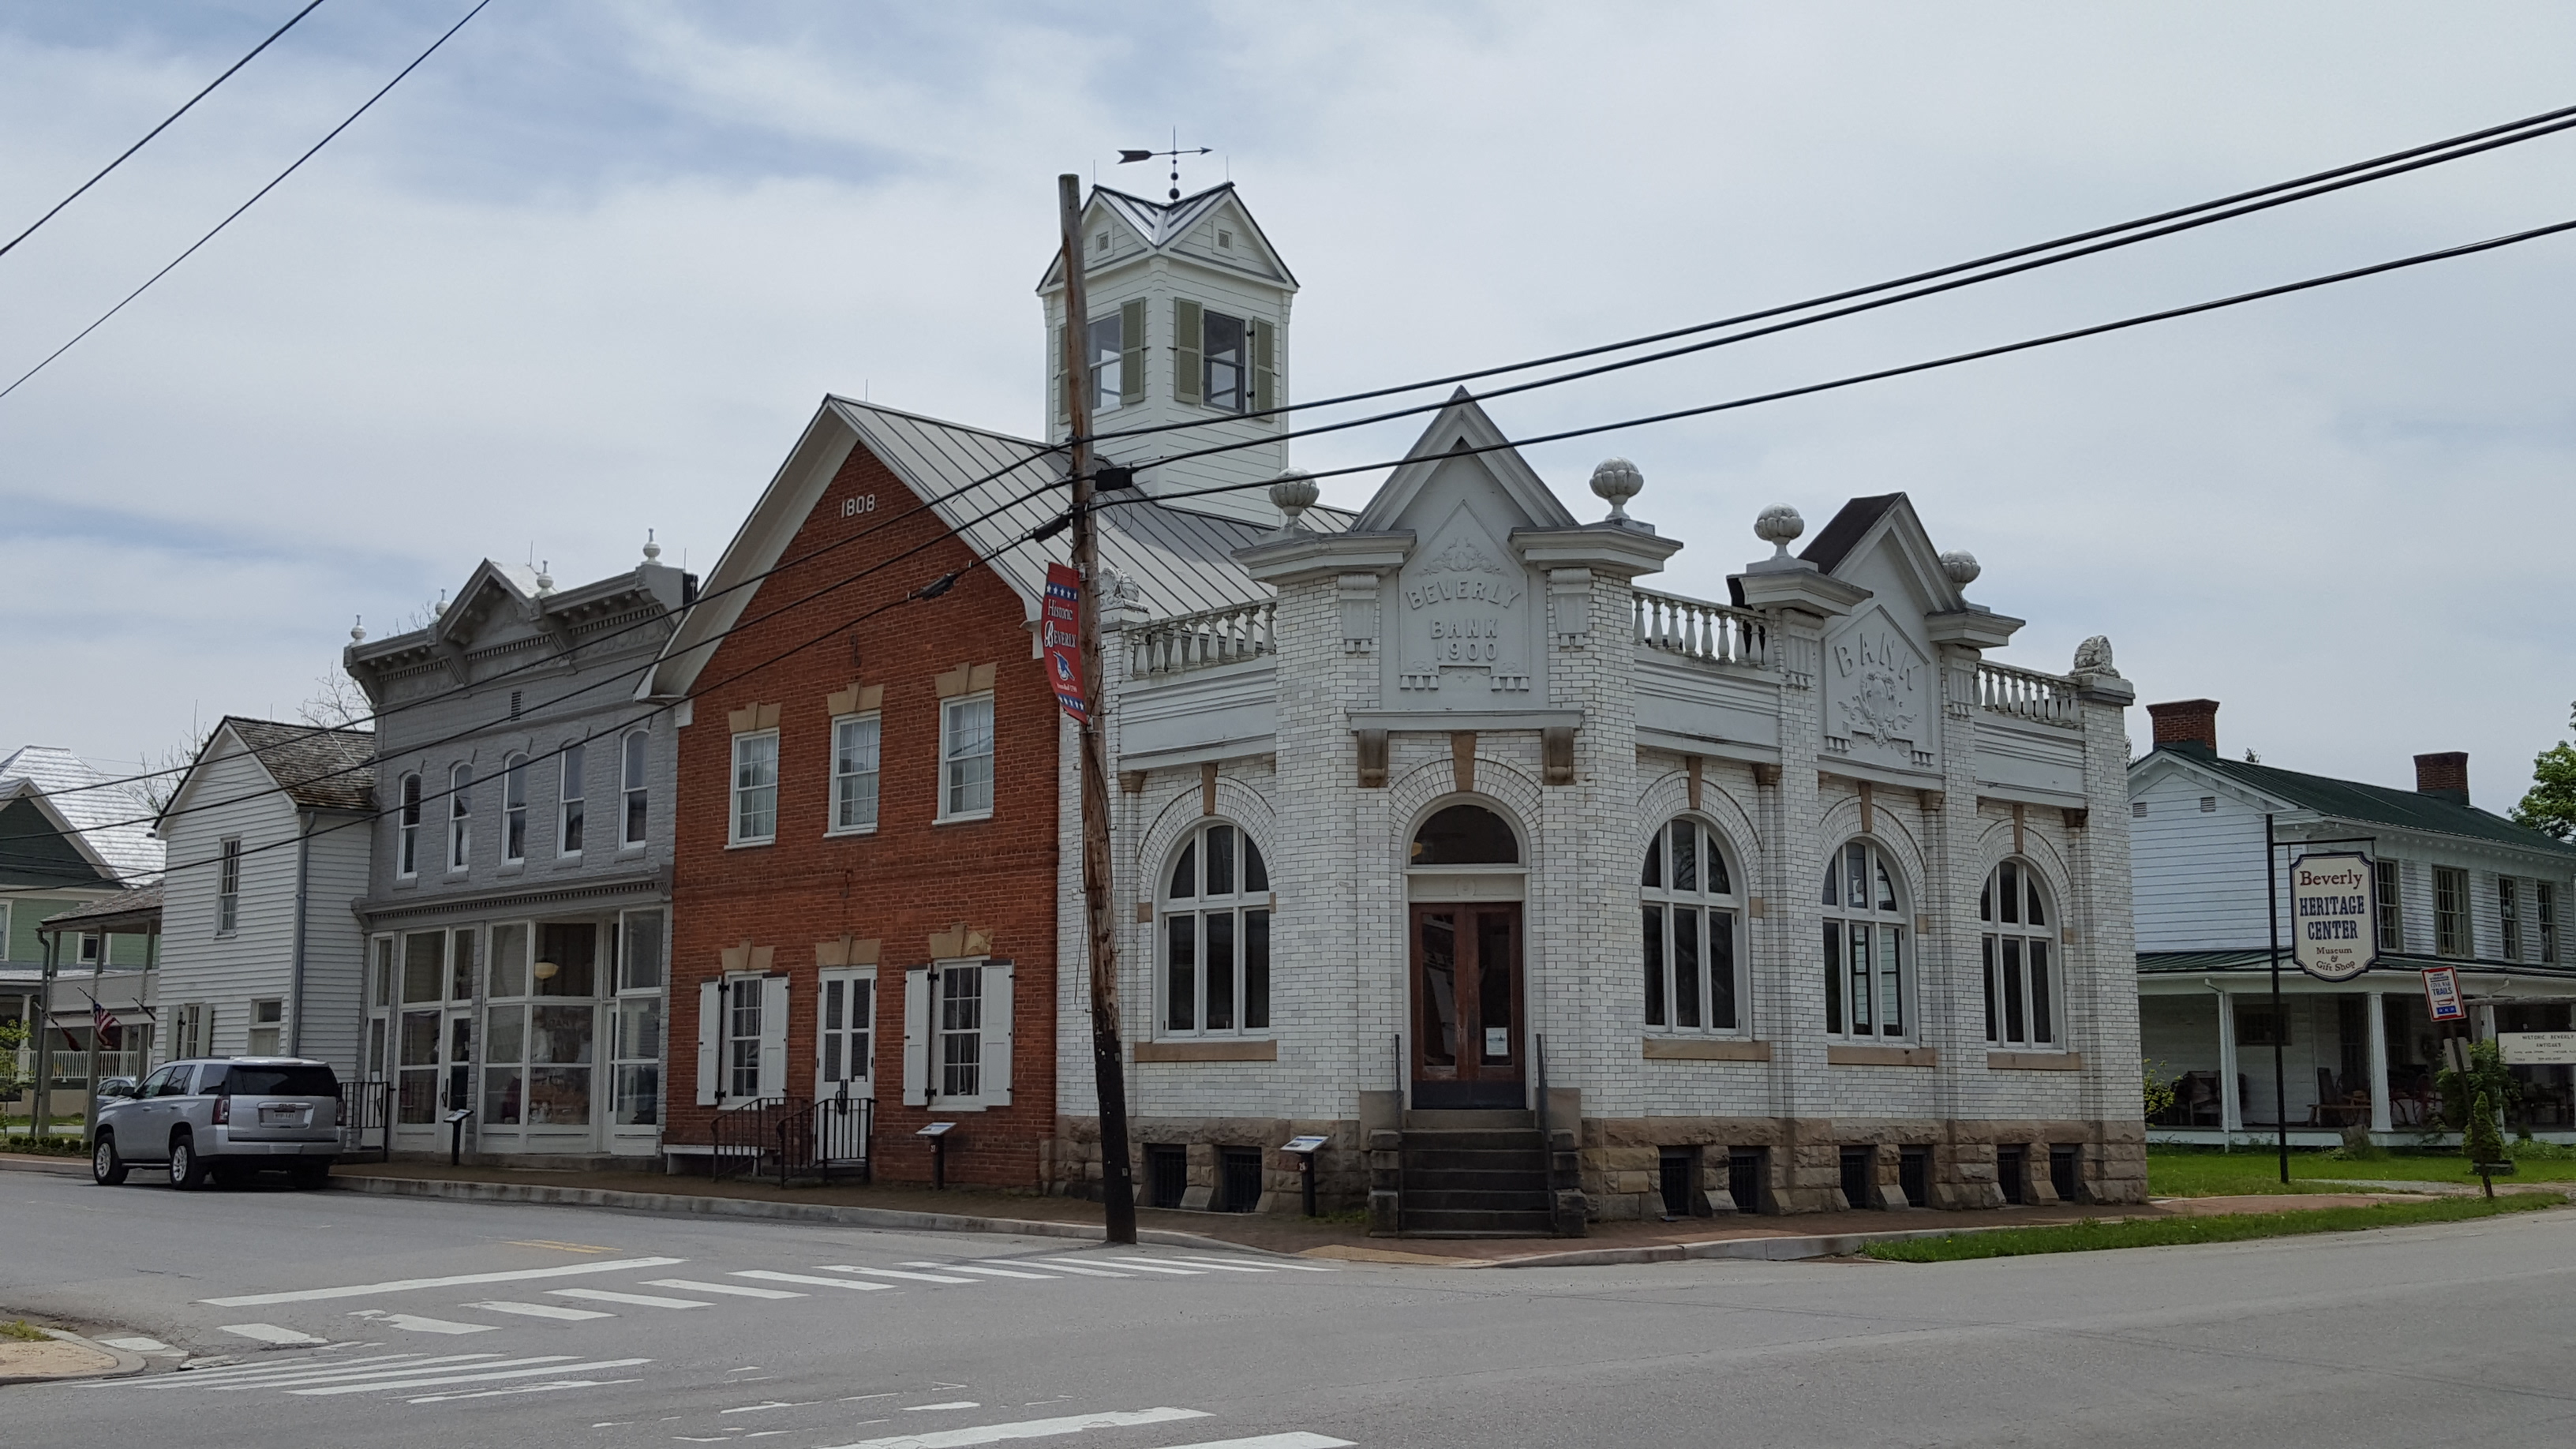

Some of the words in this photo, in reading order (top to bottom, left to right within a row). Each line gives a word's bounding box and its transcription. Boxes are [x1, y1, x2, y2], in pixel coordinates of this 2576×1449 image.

[841, 494, 875, 519] 1808
[1406, 578, 1521, 610] BEVERLY
[1047, 598, 1073, 621] Historic
[1431, 618, 1498, 639] BANK
[1436, 640, 1498, 661] 1900
[1833, 631, 1919, 691] BANK
[2299, 869, 2363, 890] Beverly
[2299, 895, 2364, 916] HERITAGE
[2308, 920, 2358, 940] CENTER
[2316, 946, 2353, 955] Museum
[2331, 954, 2338, 963] &
[2316, 960, 2333, 972] Gift
[2335, 960, 2356, 972] Shop
[2432, 987, 2453, 996] TRAILS
